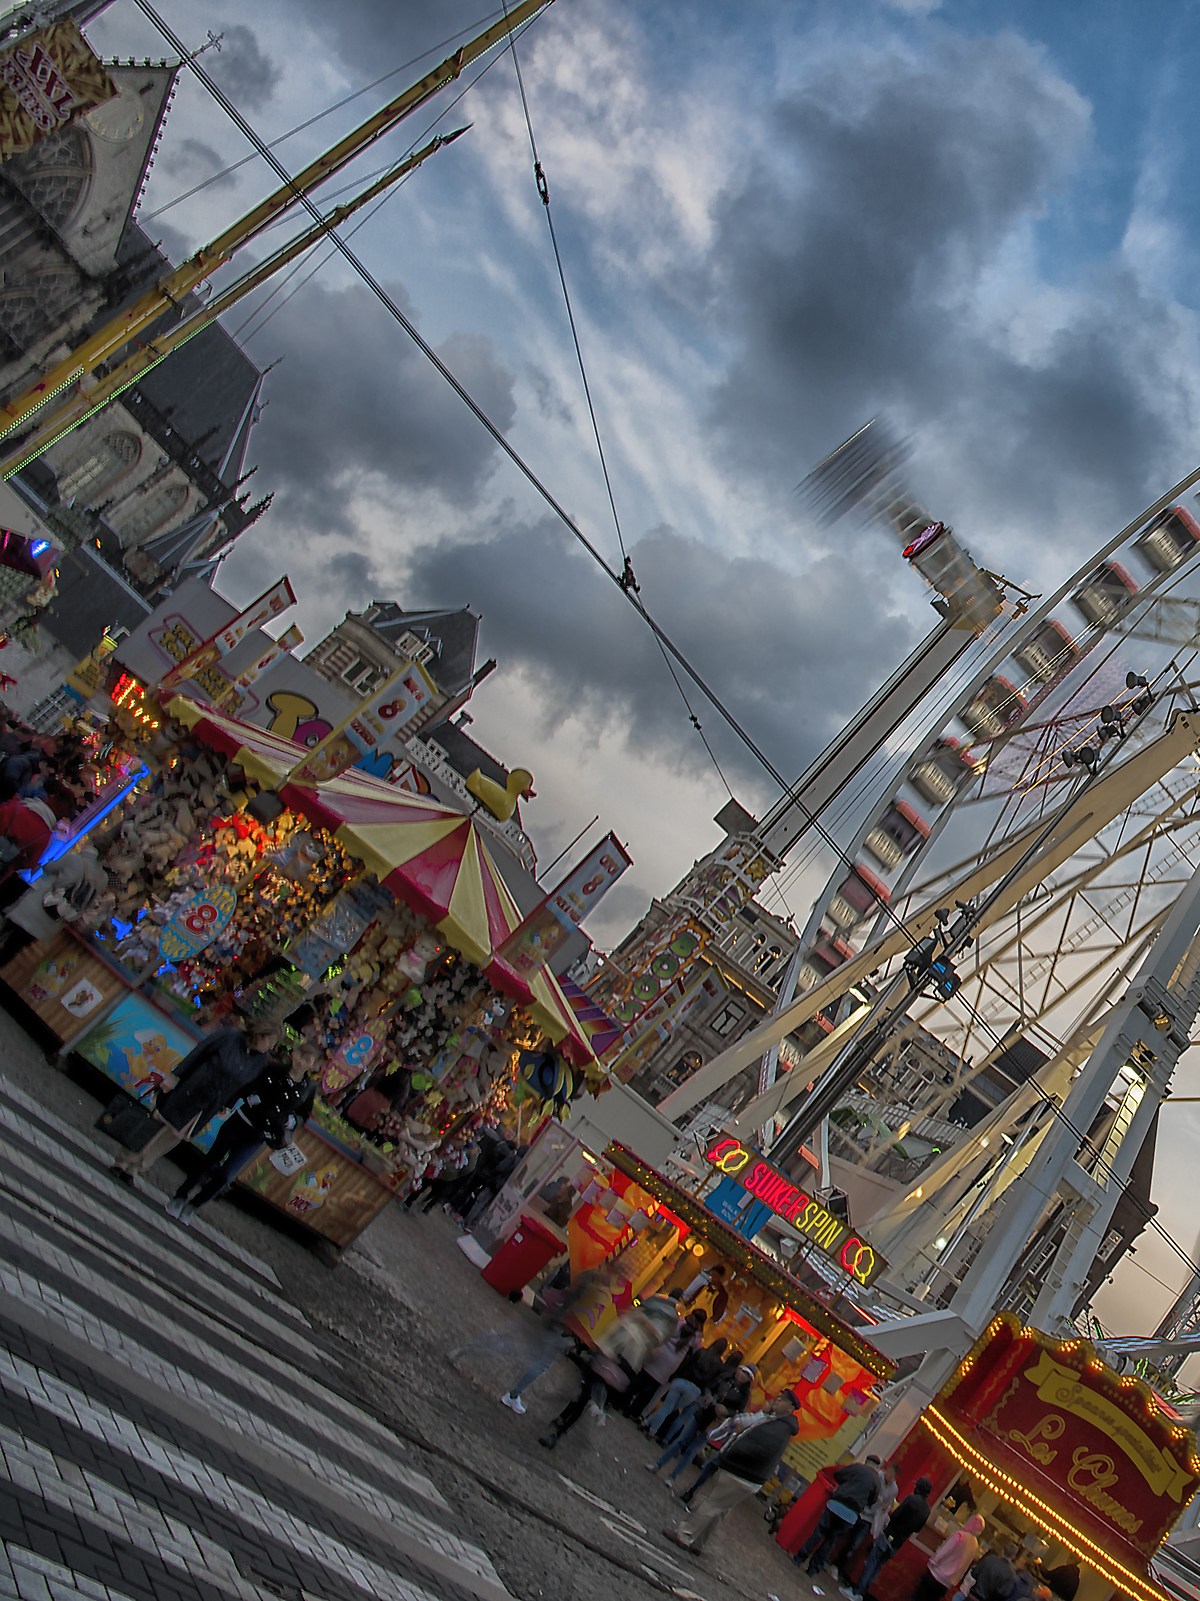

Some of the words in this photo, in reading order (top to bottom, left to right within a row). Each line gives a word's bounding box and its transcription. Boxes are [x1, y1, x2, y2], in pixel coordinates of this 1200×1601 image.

[1, 58, 56, 130] FRITES
[16, 41, 76, 121] XXL
[185, 904, 218, 936] 8
[345, 1035, 374, 1065] 8
[743, 1163, 843, 1249] SUIKERSPIN
